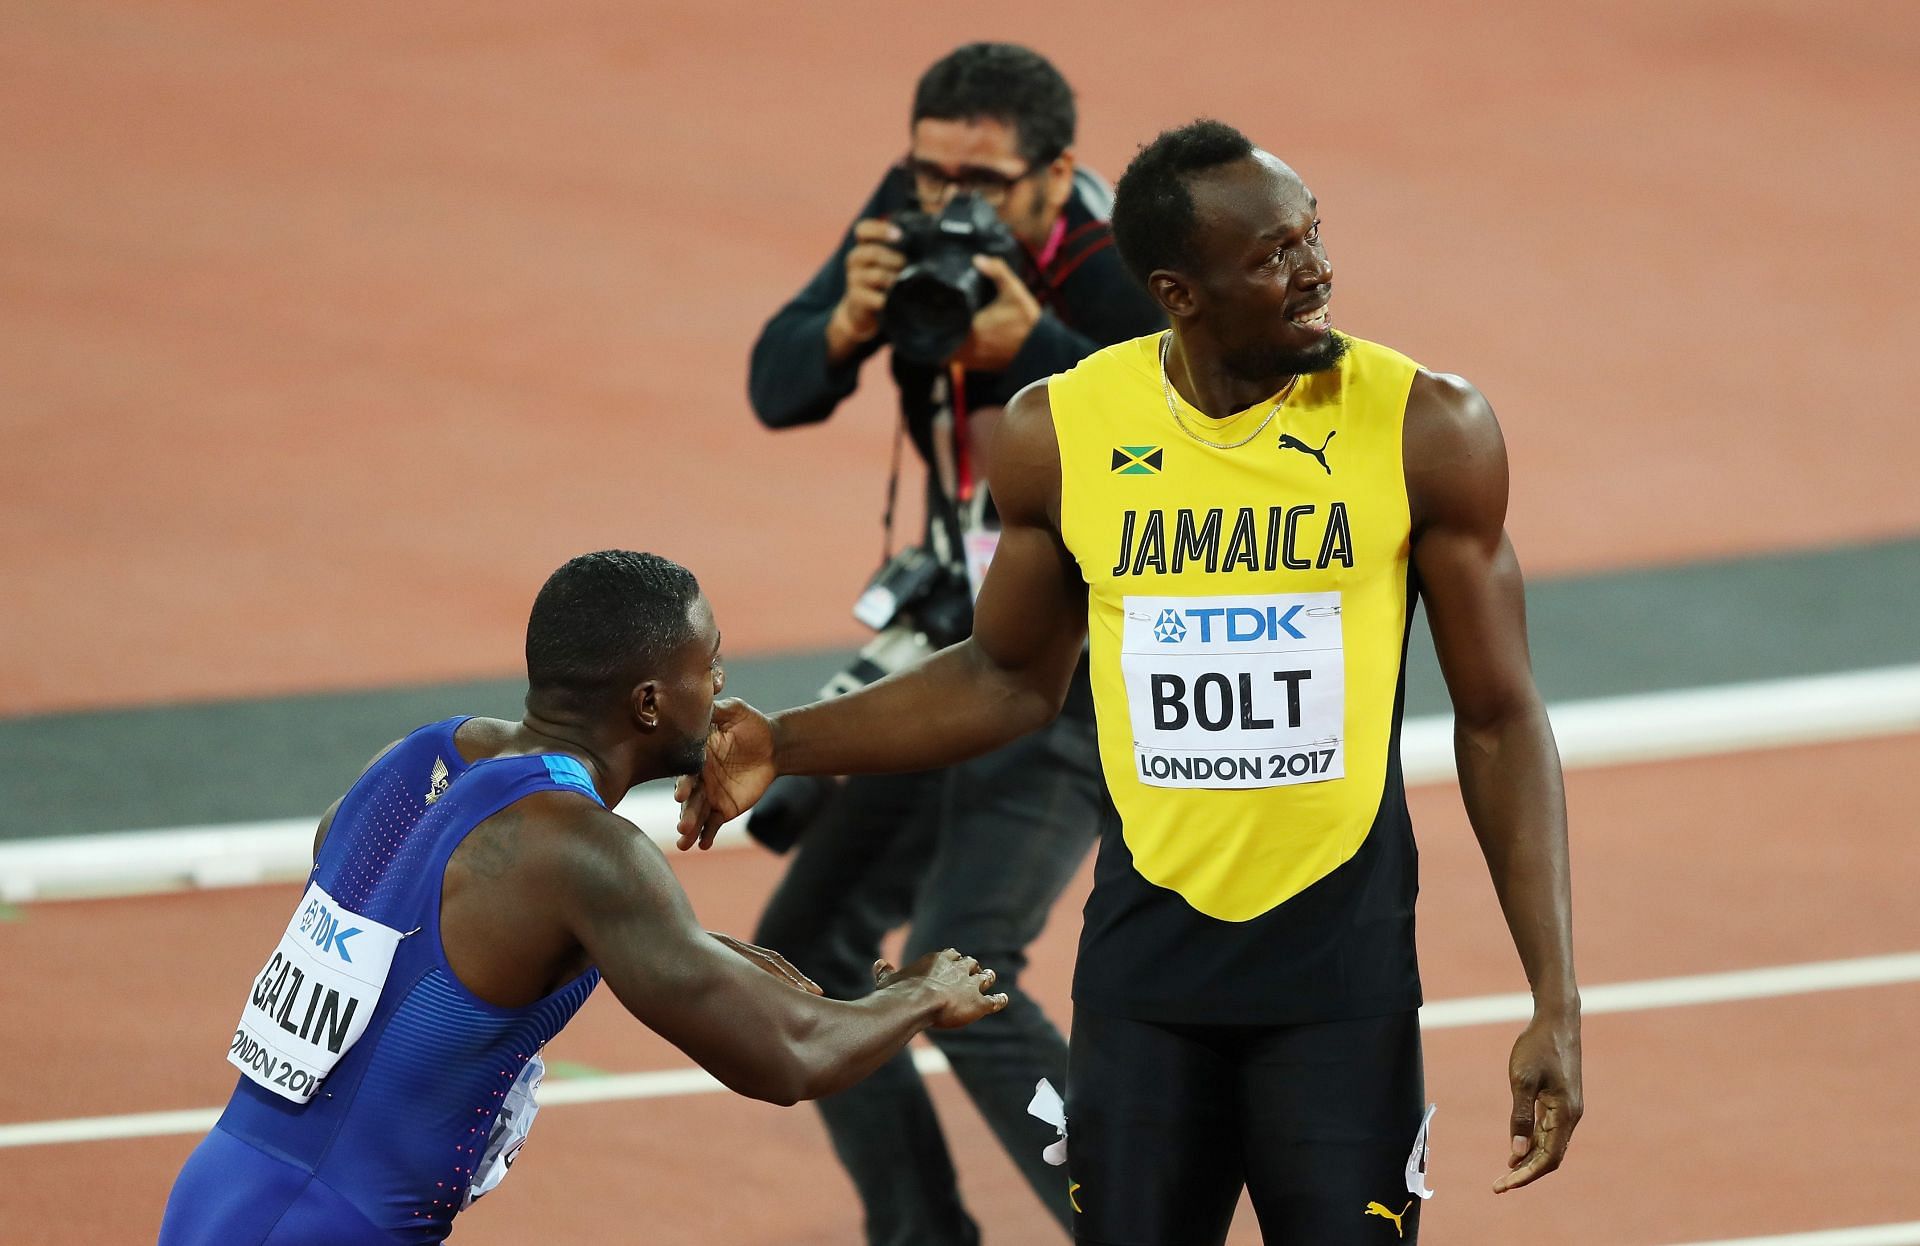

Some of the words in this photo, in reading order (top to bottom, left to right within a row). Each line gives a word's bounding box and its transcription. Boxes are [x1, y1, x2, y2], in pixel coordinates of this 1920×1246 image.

[1113, 502, 1353, 576] JAMAICA
[1185, 604, 1306, 642] TDK
[1151, 670, 1311, 731] BOLT
[1141, 754, 1262, 780] LONDON
[1268, 749, 1336, 778] 2017
[231, 1030, 277, 1079] ONDON
